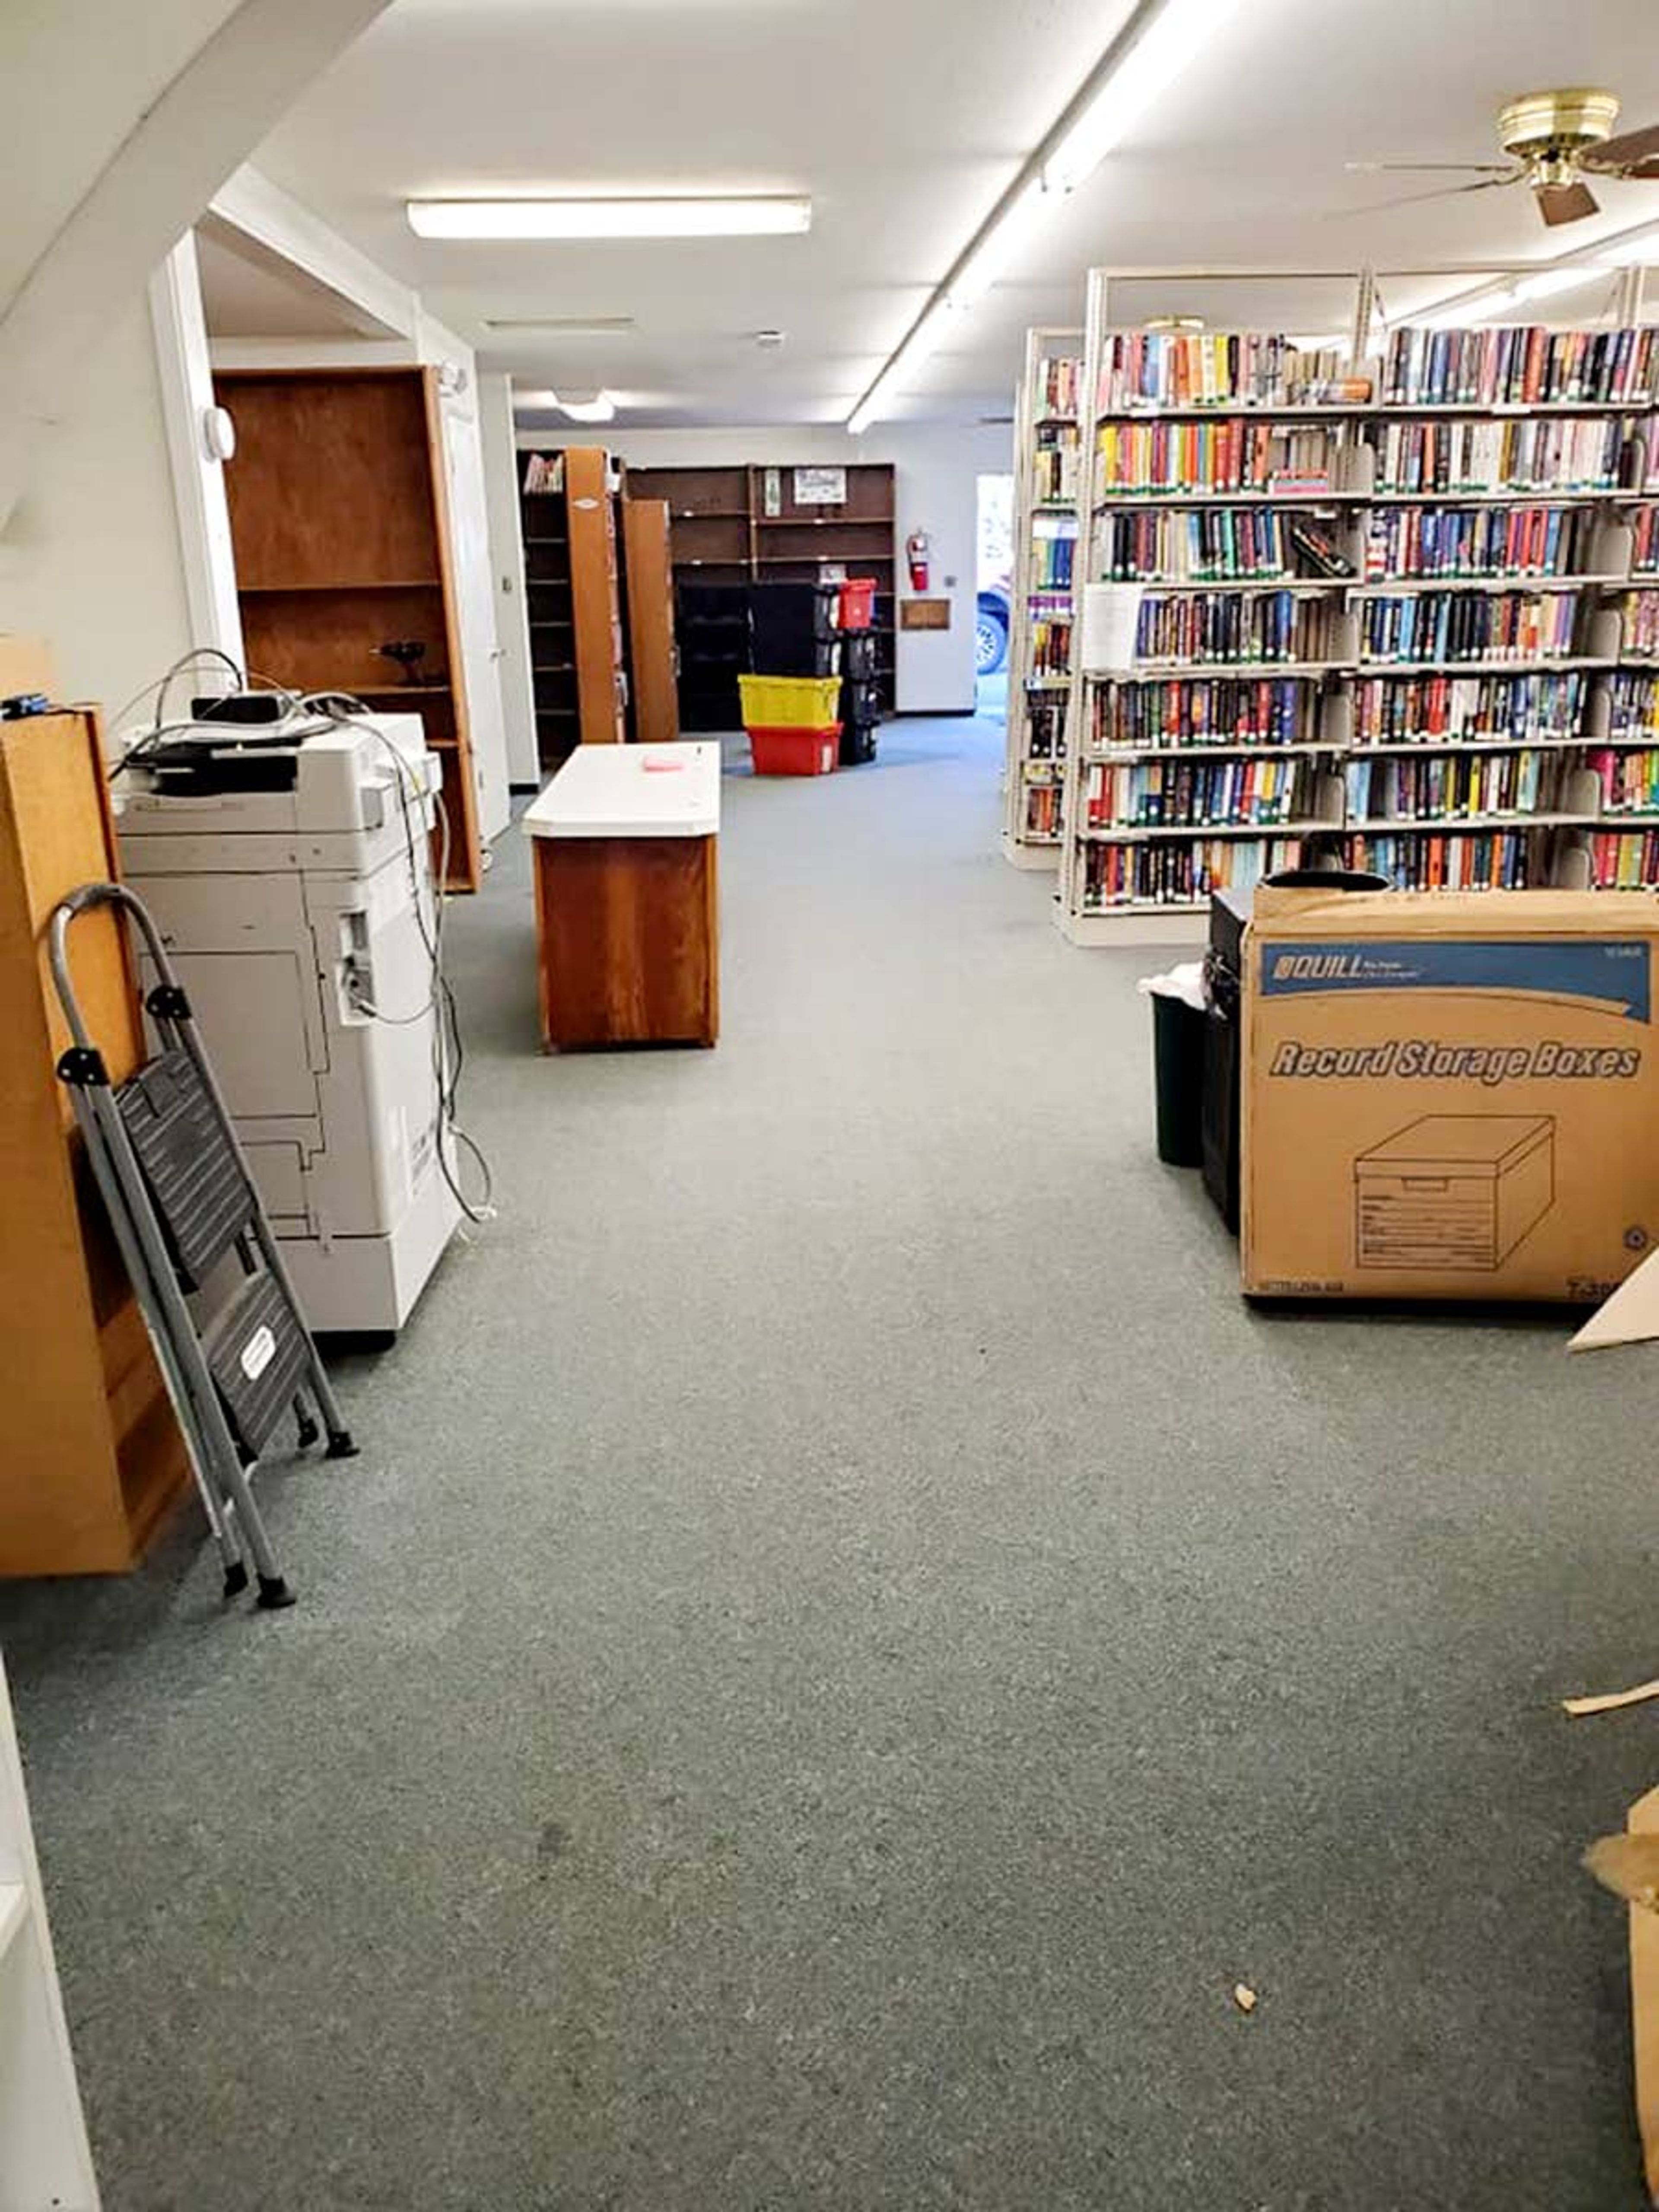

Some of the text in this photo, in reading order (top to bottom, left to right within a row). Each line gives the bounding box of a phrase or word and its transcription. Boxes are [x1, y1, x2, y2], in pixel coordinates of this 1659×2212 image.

[1293, 954, 1362, 978] QUILL
[1269, 1040, 1641, 1087] Record Storage Boxes
